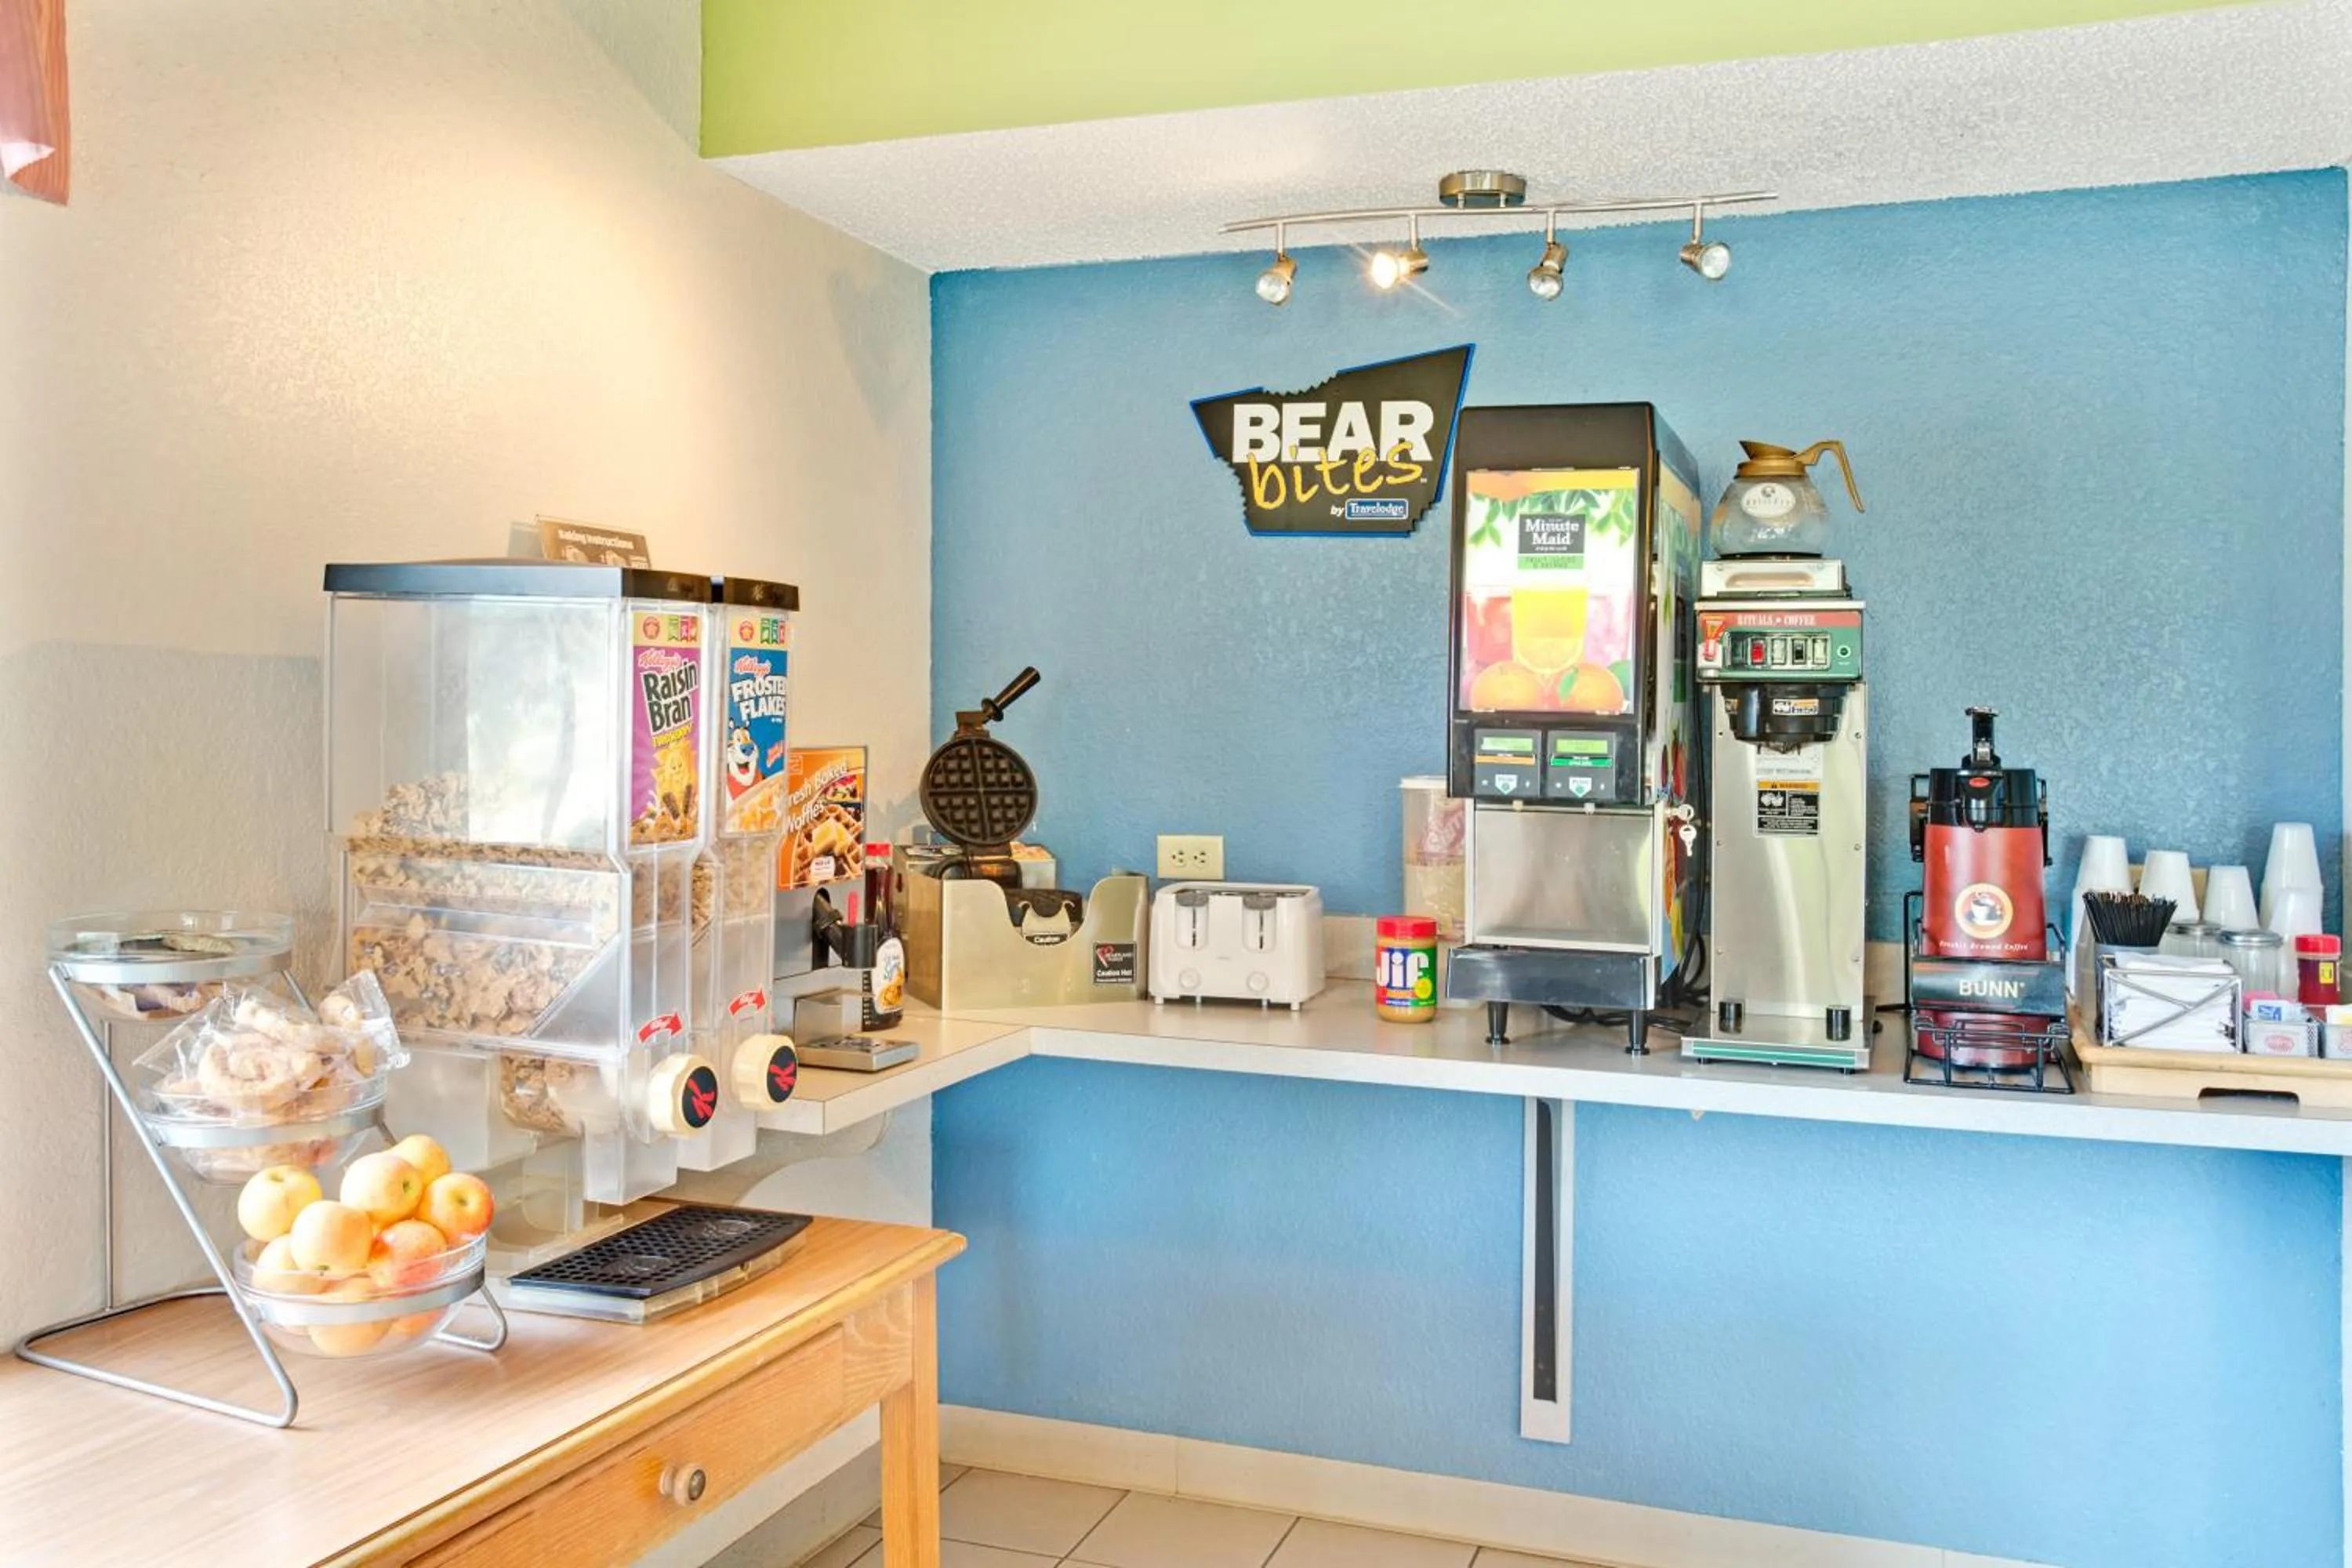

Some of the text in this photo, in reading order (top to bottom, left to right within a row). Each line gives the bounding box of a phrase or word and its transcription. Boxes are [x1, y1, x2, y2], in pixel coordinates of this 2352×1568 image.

[1232, 401, 1434, 463] BEAR
[1247, 441, 1423, 510] bites
[1330, 501, 1404, 517] by Travelodge
[1525, 518, 1580, 532] Minute
[1532, 532, 1572, 545] Maid
[643, 661, 697, 701] Raisin
[731, 676, 786, 702] FROSTE
[649, 695, 691, 733] Bran
[1377, 951, 1429, 987] Jif
[1959, 980, 2020, 999] BUNN
